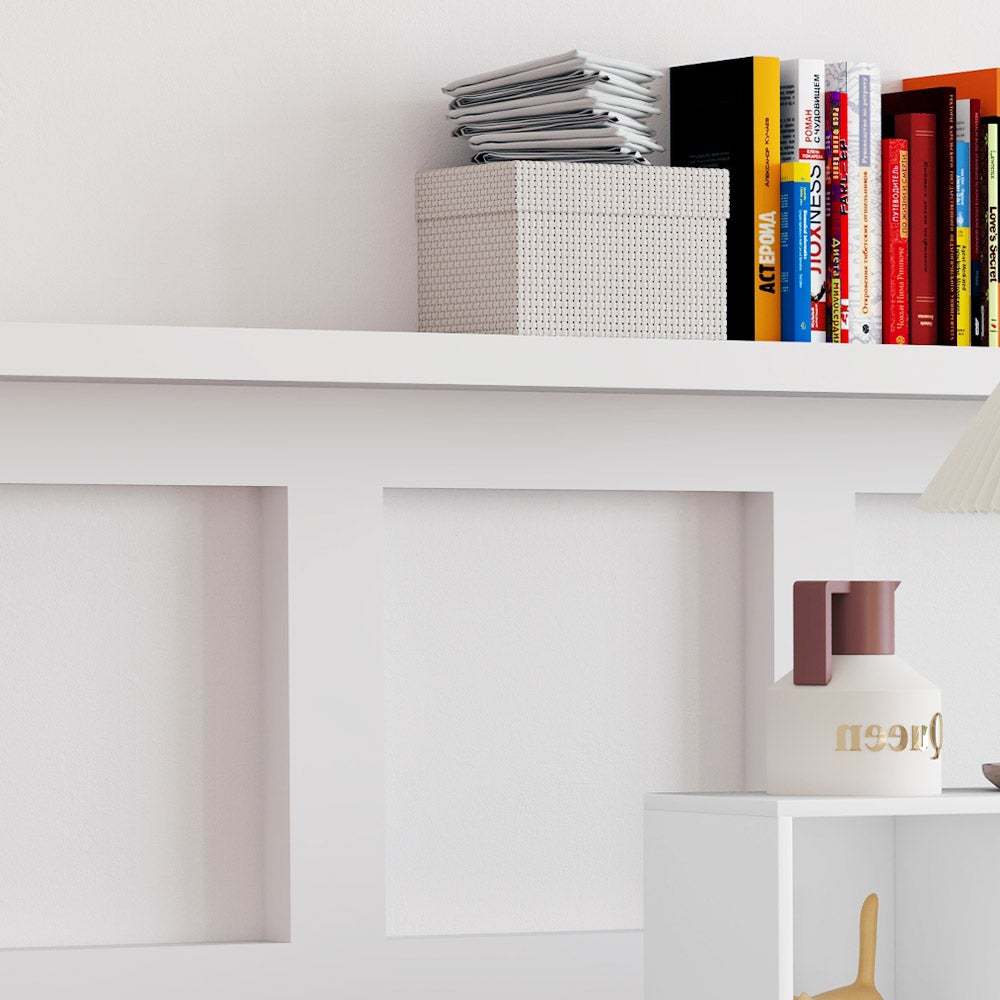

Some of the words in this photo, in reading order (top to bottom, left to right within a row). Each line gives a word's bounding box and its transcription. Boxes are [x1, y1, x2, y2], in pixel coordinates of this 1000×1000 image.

[804, 109, 812, 143] РОМАН
[813, 74, 822, 135] ЧУДОВИЩЕМ
[861, 171, 870, 222] отшельников
[892, 165, 900, 222] ПУТЕВОДИТЕЛЬ
[861, 224, 870, 263] тибетских
[990, 206, 998, 243] Love's
[758, 210, 776, 294] АСТЕРОИД
[832, 237, 841, 277] Диета
[990, 246, 998, 283] Secret
[861, 265, 870, 315] Откровения
